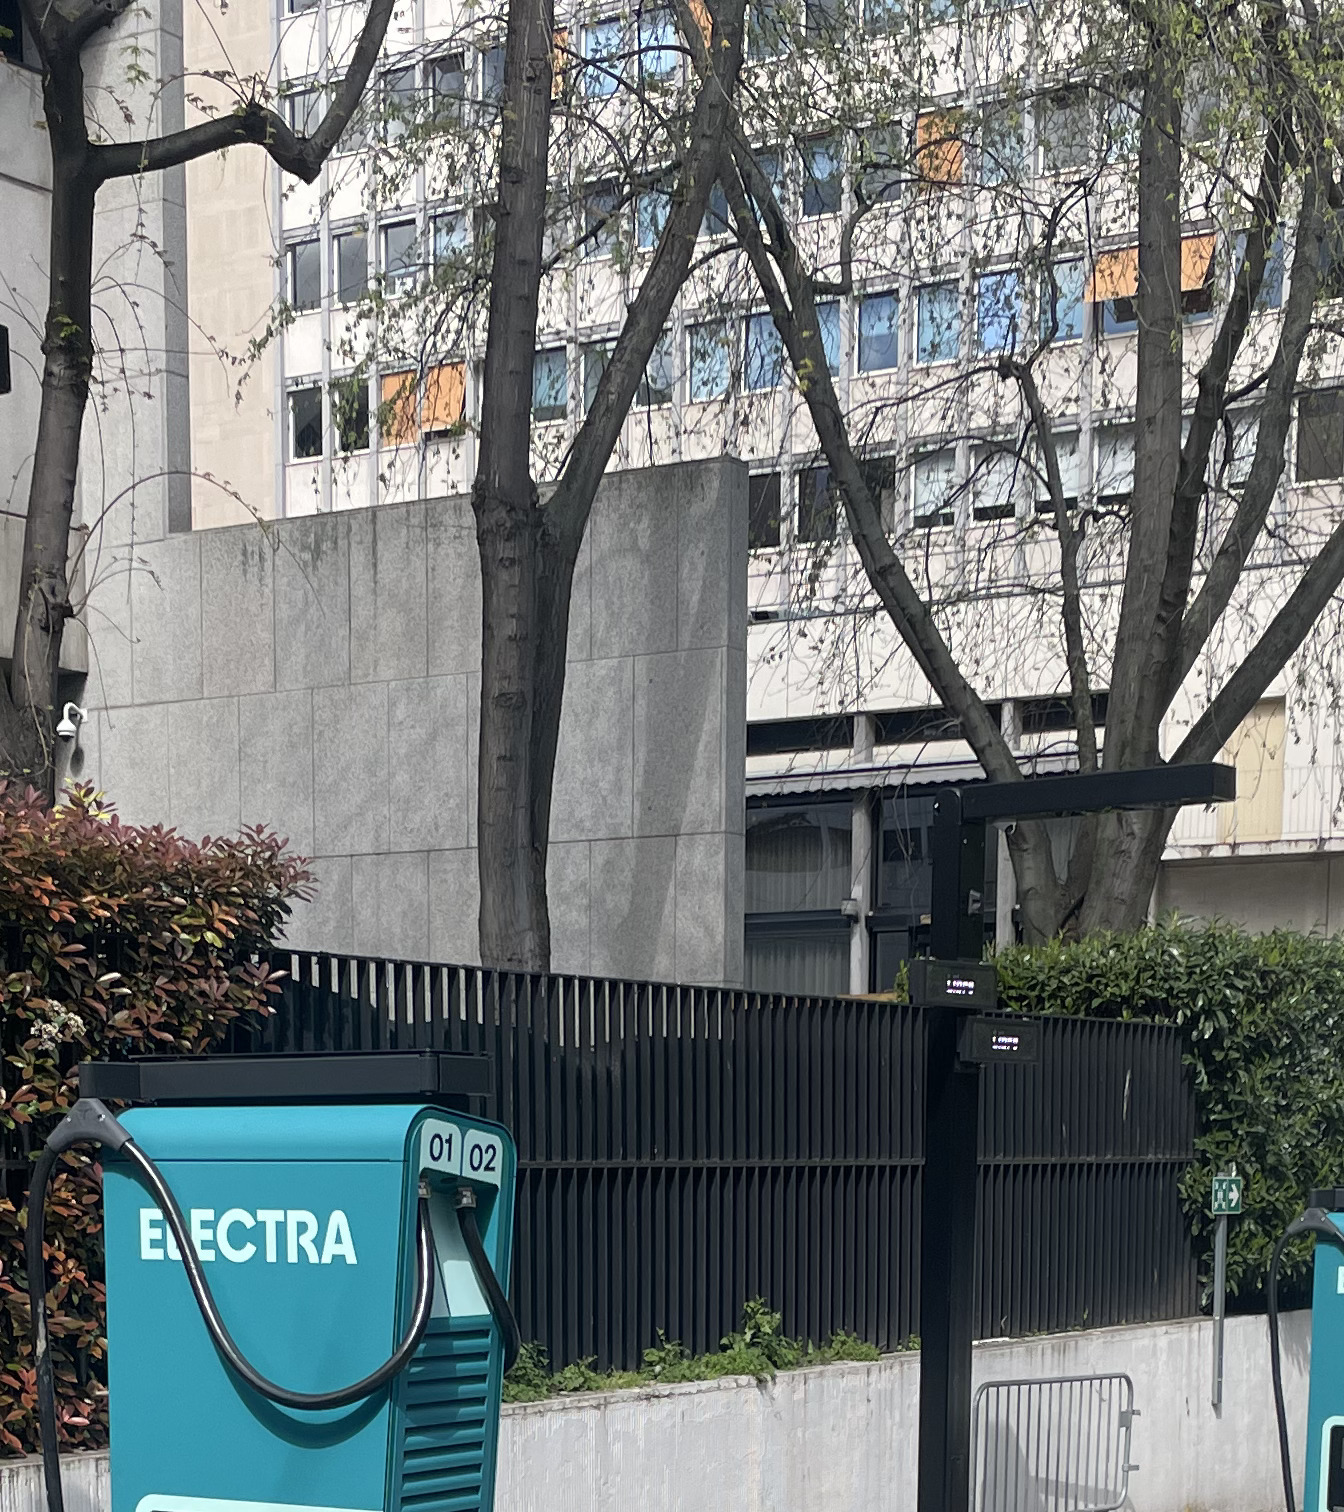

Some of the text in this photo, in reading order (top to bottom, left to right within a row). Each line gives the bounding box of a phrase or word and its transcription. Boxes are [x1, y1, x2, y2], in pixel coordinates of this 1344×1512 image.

[429, 1133, 454, 1163] 01
[469, 1142, 497, 1173] 02
[139, 1207, 358, 1265] ELECTRA
